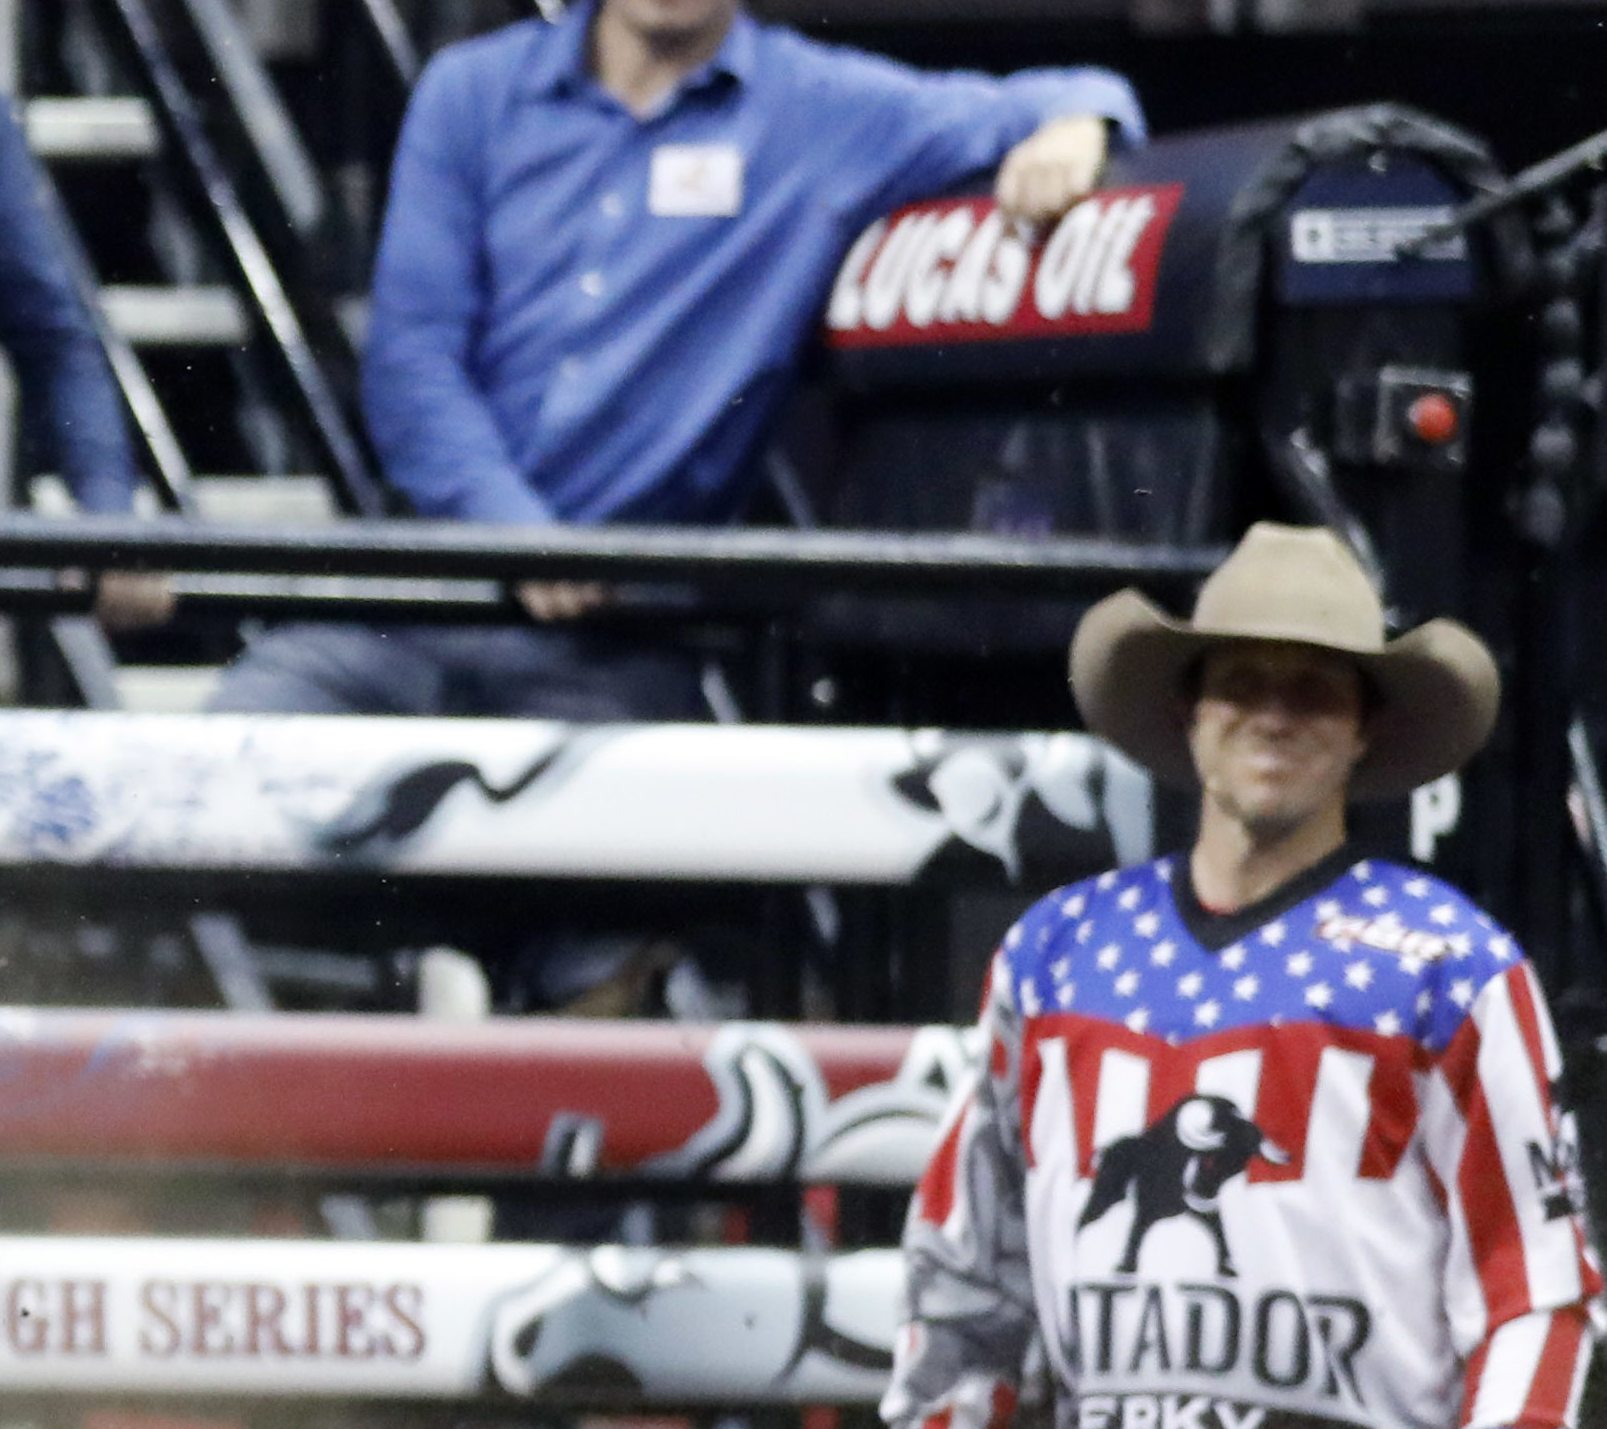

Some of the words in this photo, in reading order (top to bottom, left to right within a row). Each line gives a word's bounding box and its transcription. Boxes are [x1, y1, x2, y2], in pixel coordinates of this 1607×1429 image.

[826, 204, 1034, 331] LUCAS
[1033, 193, 1156, 321] OIL
[138, 1278, 427, 1360] SERIES
[1067, 1280, 1372, 1408] TADOR
